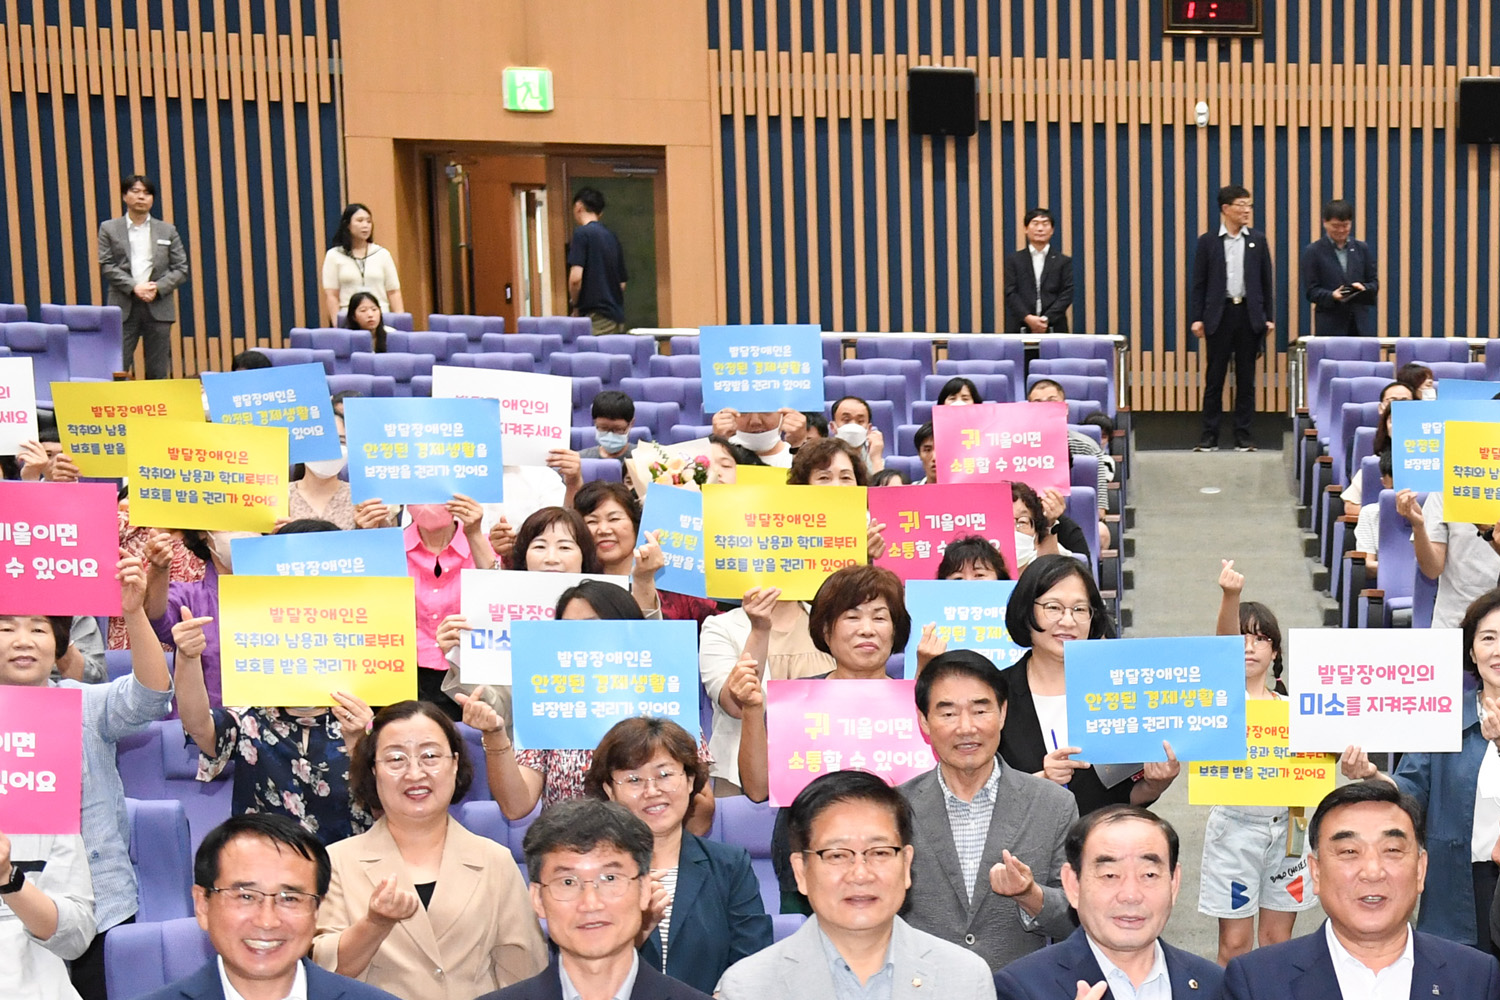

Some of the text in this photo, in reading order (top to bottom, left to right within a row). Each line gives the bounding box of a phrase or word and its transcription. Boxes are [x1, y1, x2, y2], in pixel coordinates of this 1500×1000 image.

[729, 344, 792, 358] 발달장애인은
[713, 361, 810, 375] 안정된 경제생활을
[714, 380, 749, 392] 보장받을
[782, 379, 811, 391] 있어요
[384, 423, 464, 437] 발달장애인은
[961, 429, 1042, 450] 귀 기울이면
[168, 447, 248, 464] 발달장애인은
[363, 442, 485, 458] 안정된 경제생활을
[365, 464, 488, 479] 보장받을 권리가 있어요
[950, 455, 1055, 473] 소통할 수 있어요
[1453, 465, 1486, 478] 착취와
[139, 466, 278, 485] 착취와 남용과 학대로부터
[140, 488, 277, 510] 보호를 받을 권리가 있어요
[1453, 486, 1480, 499] 보호를
[744, 513, 826, 528] 발달장애인은
[899, 511, 986, 531] 귀 기울이면
[715, 535, 857, 550] 착취와 남용과 학대로부터
[888, 540, 931, 559] 소통할
[6, 557, 98, 579] 수 있어요
[715, 557, 816, 572] 보호를 받을 권리가
[269, 607, 368, 624] 발달장애인은
[234, 632, 404, 649] 착취와 남용과 학대로부터
[235, 658, 404, 675] 보호를 받을 권리가 있어요
[557, 651, 652, 668] 발달장애인은
[1110, 666, 1201, 685] 발달장애인은
[1318, 665, 1434, 685] 발달장애인의
[531, 674, 681, 694] 안정된 경제생활을
[1085, 688, 1227, 711] 안정된 경제생활을
[1300, 693, 1452, 716] 미소를 지켜주세요
[532, 702, 634, 718] 보장받을 권리가
[804, 713, 912, 740] 귀 기울이면
[1086, 715, 1227, 734] 보장받을 권리가 있어요
[788, 749, 930, 770] 소통할 수 있어요
[1200, 765, 1325, 780] 보호를 받을 권리가 있어요
